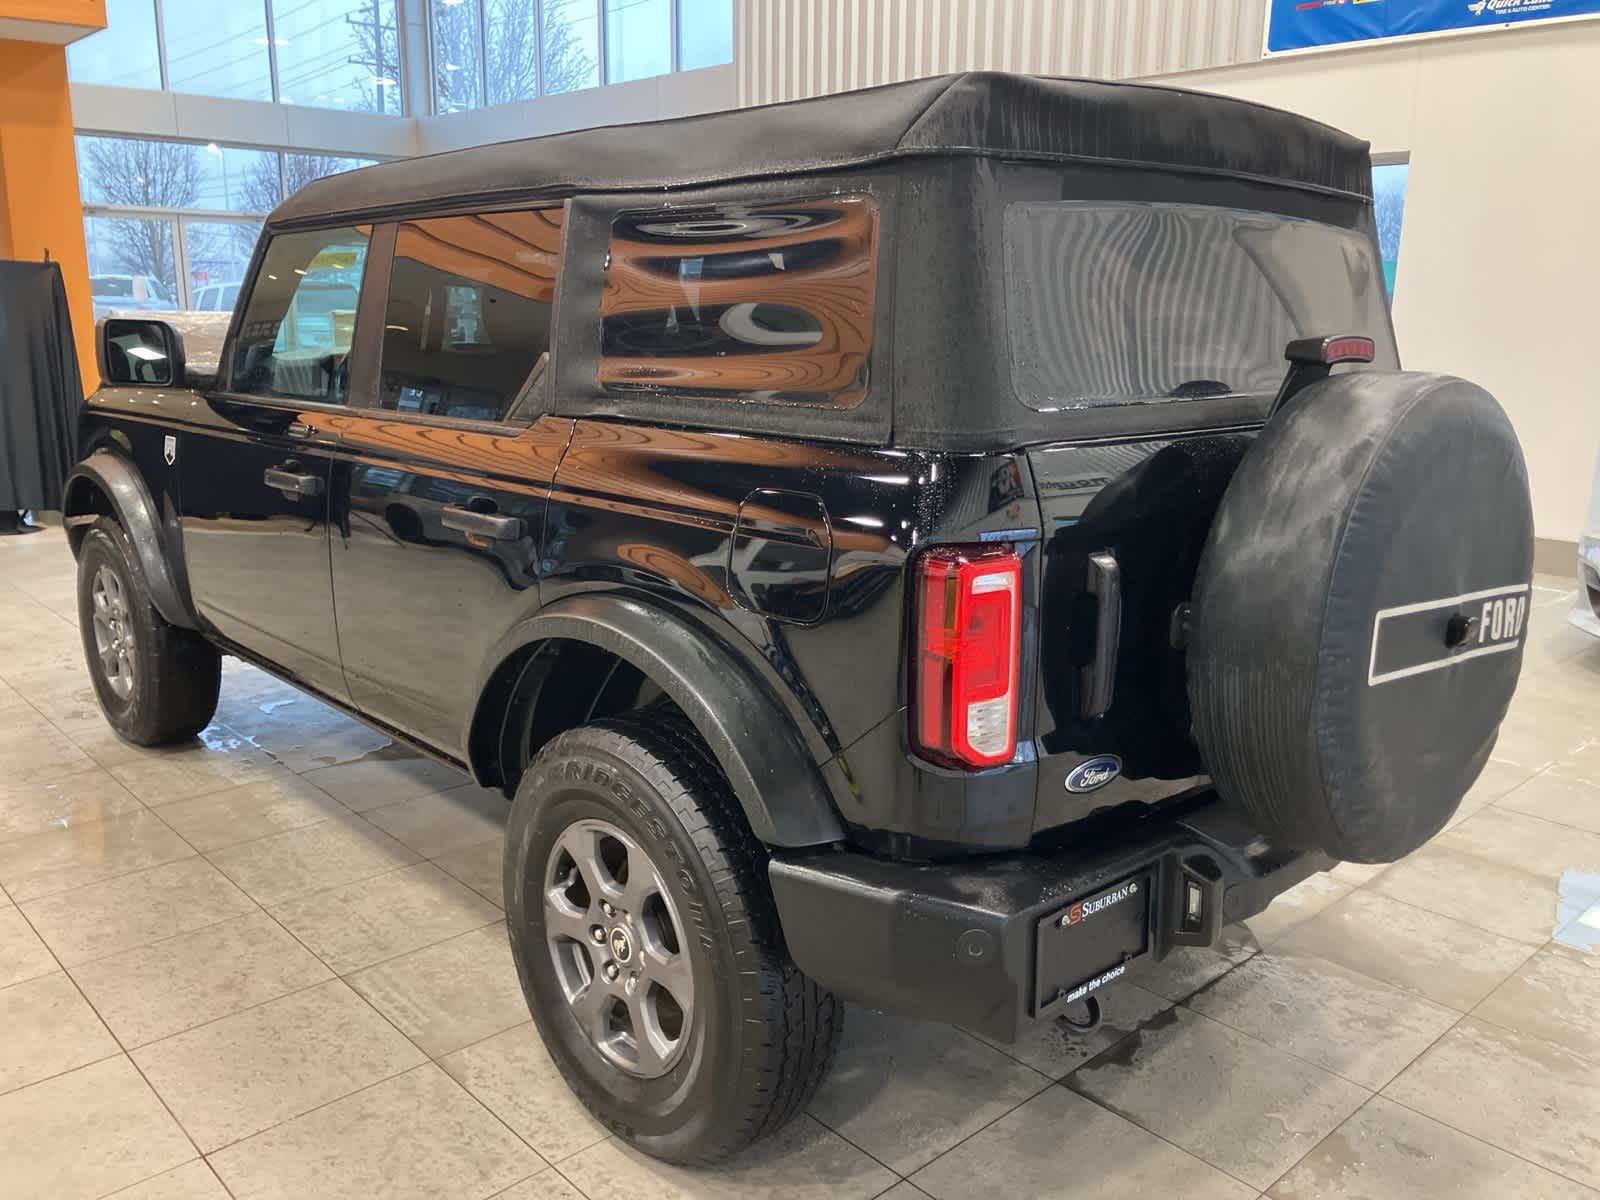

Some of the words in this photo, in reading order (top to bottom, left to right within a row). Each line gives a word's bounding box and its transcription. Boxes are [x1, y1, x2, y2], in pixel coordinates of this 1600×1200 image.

[1478, 596, 1526, 643] FORD
[1080, 768, 1110, 787] Ford
[1067, 986, 1087, 1003] make
[1089, 979, 1100, 991] the
[1102, 966, 1125, 983] choice
